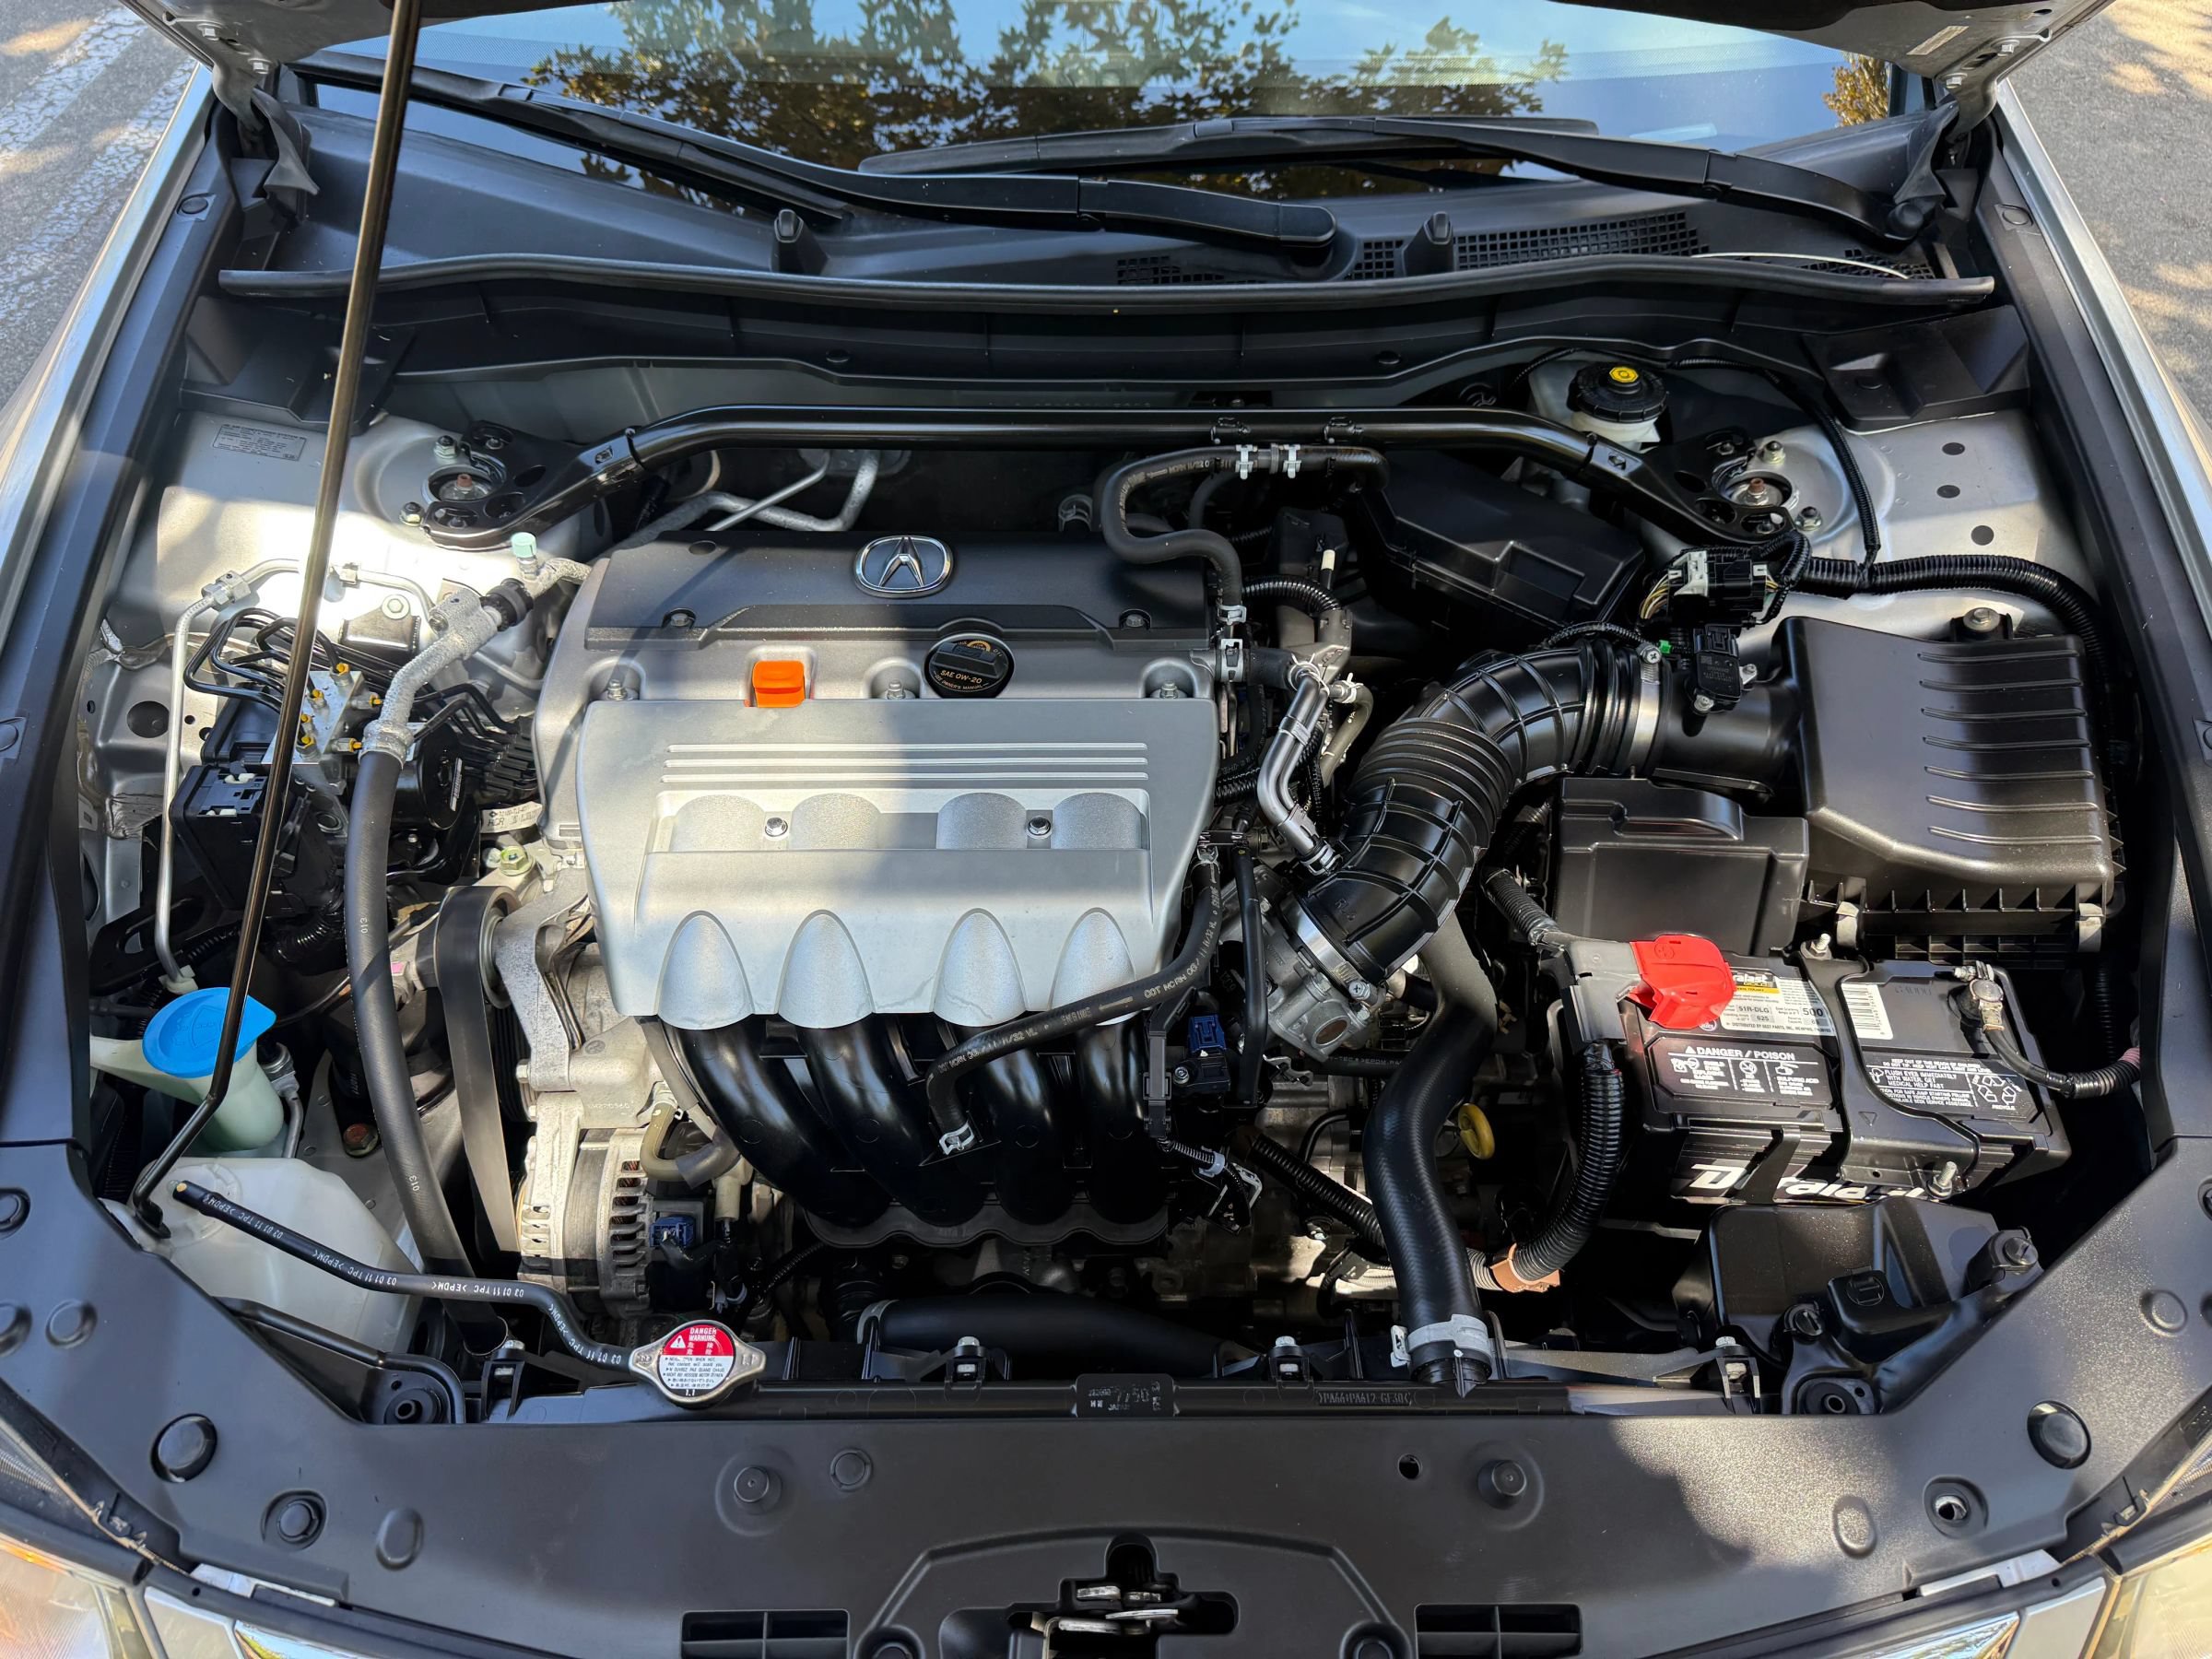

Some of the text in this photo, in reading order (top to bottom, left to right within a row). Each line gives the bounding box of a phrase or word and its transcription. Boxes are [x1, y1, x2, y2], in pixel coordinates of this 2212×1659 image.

[940, 669, 955, 678] SAE
[1696, 1047, 1743, 1057] DANGER
[1754, 1051, 1795, 1060] POISON
[409, 1175, 419, 1191] 013
[238, 1212, 254, 1224] TPC
[274, 1230, 283, 1239] 03
[347, 1266, 363, 1279] TPC
[374, 1276, 384, 1284] 01
[387, 1277, 396, 1286] 03
[473, 1285, 491, 1294] TPC
[492, 1287, 501, 1296] 11
[502, 1288, 512, 1297] 01
[514, 1289, 524, 1298] 03
[568, 1338, 582, 1356] TPC
[597, 1353, 607, 1363] 01
[610, 1355, 622, 1365] 03
